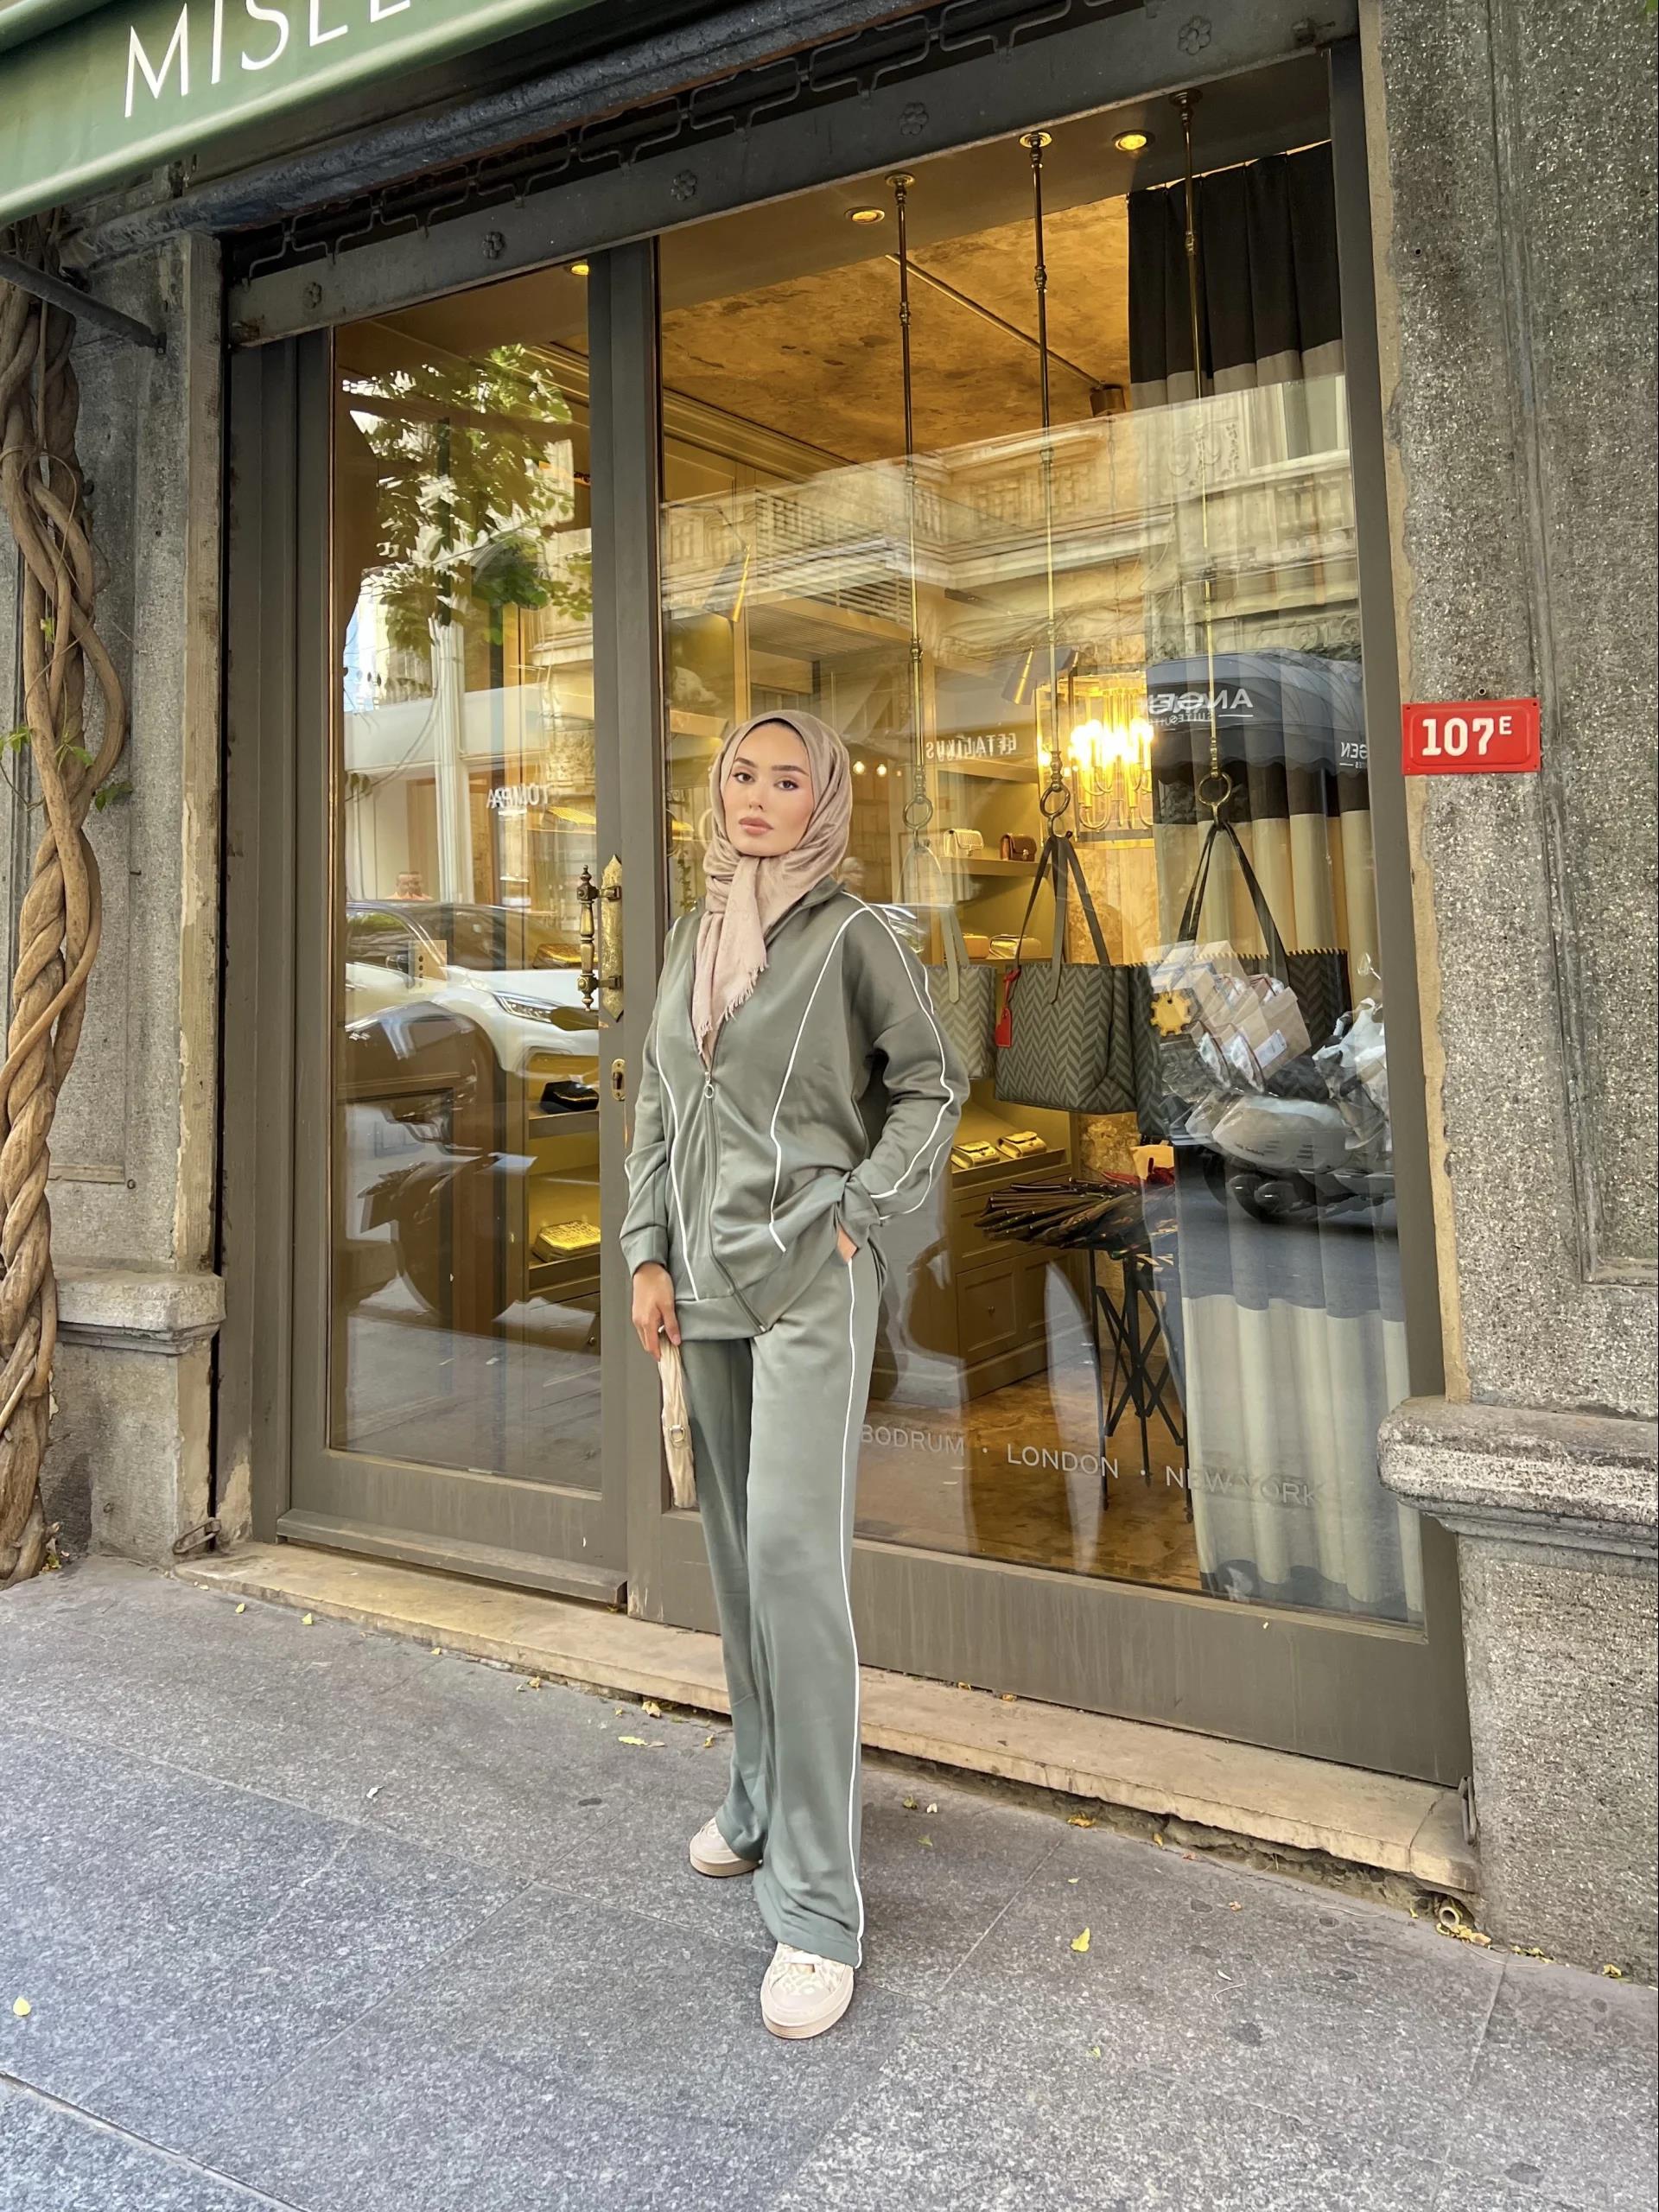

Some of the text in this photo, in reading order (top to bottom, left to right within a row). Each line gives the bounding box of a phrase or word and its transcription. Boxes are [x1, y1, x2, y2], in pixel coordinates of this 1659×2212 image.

[124, 0, 410, 118] MIS
[861, 1424, 1325, 1507] BODRUM LONDON NEW YORK
